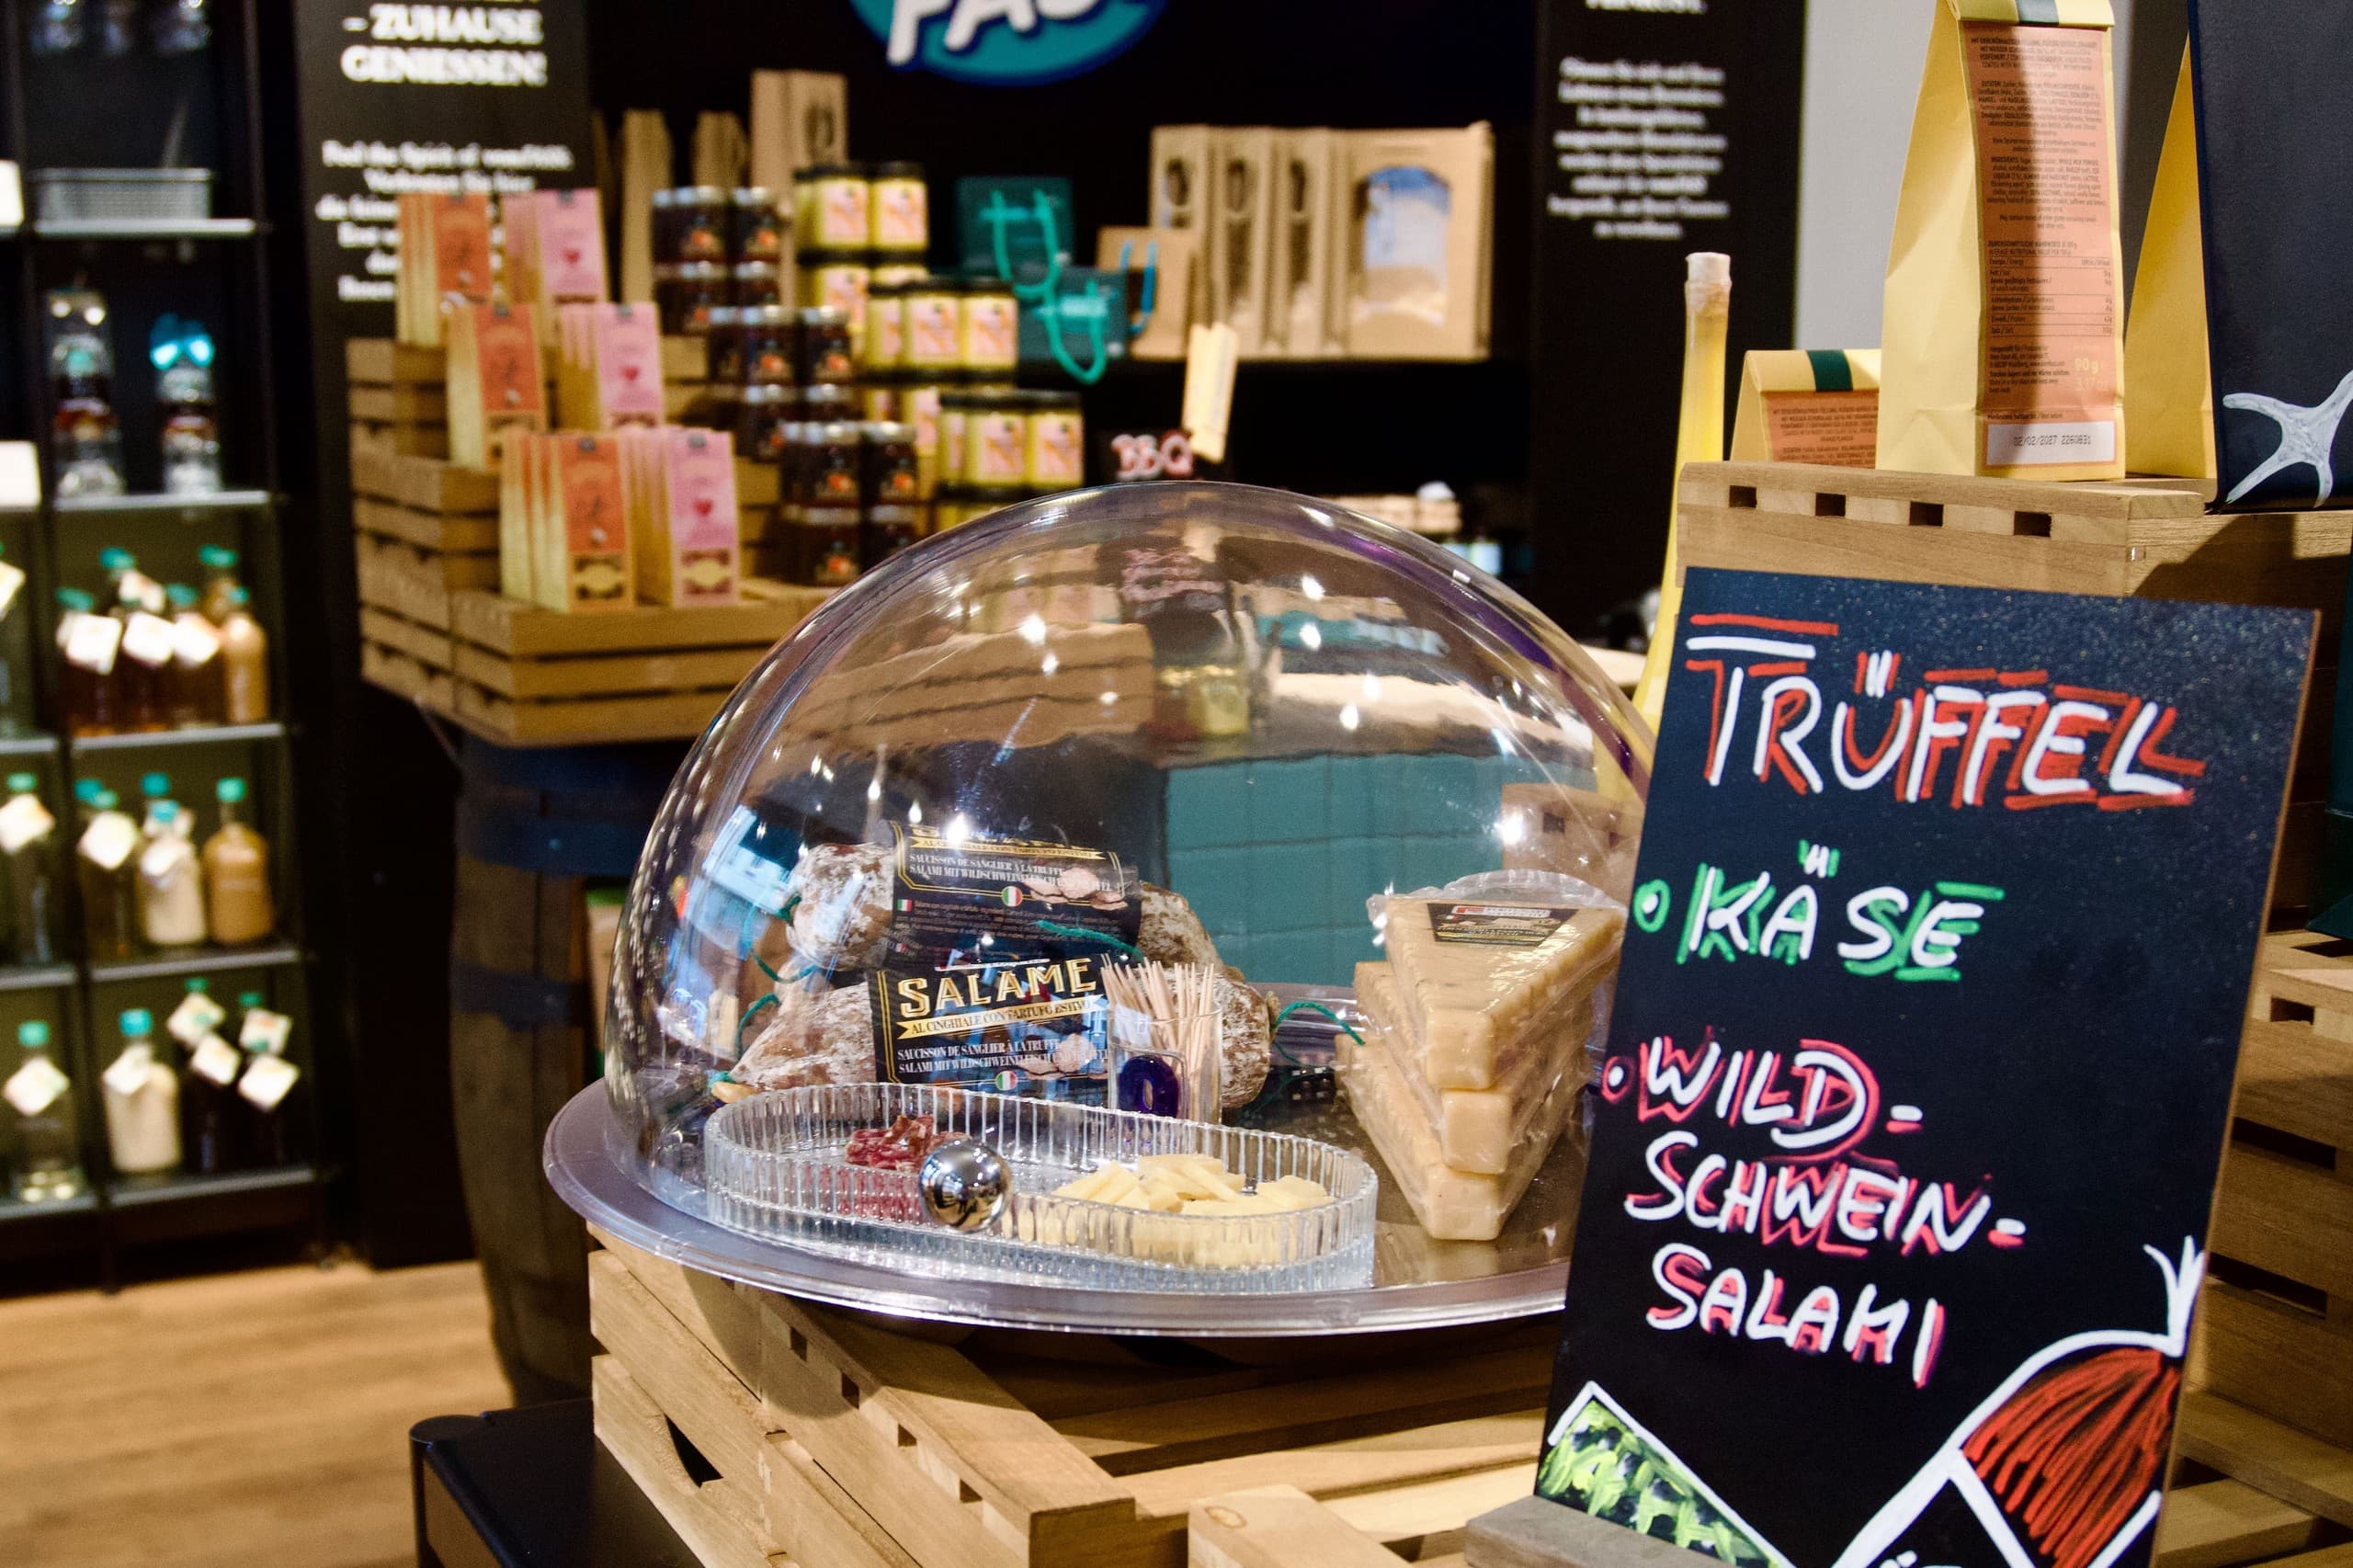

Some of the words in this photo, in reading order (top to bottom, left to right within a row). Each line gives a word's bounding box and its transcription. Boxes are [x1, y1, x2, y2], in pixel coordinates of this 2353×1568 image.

[369, 4, 543, 44] ZUHAUSE
[1686, 614, 2205, 810] TRÜFFEL
[1677, 840, 2005, 982] KÄSE
[896, 957, 1097, 1018] SALAME
[926, 1015, 982, 1031] CINGHIALE
[897, 1045, 947, 1061] SAUCISSON
[960, 1042, 1006, 1056] SANGLIER
[898, 1061, 933, 1074] SALAMI
[1638, 1028, 1923, 1162] WILD-
[1624, 1130, 2026, 1257] SCHWEIN-
[1645, 1244, 1946, 1389] SALAMI
